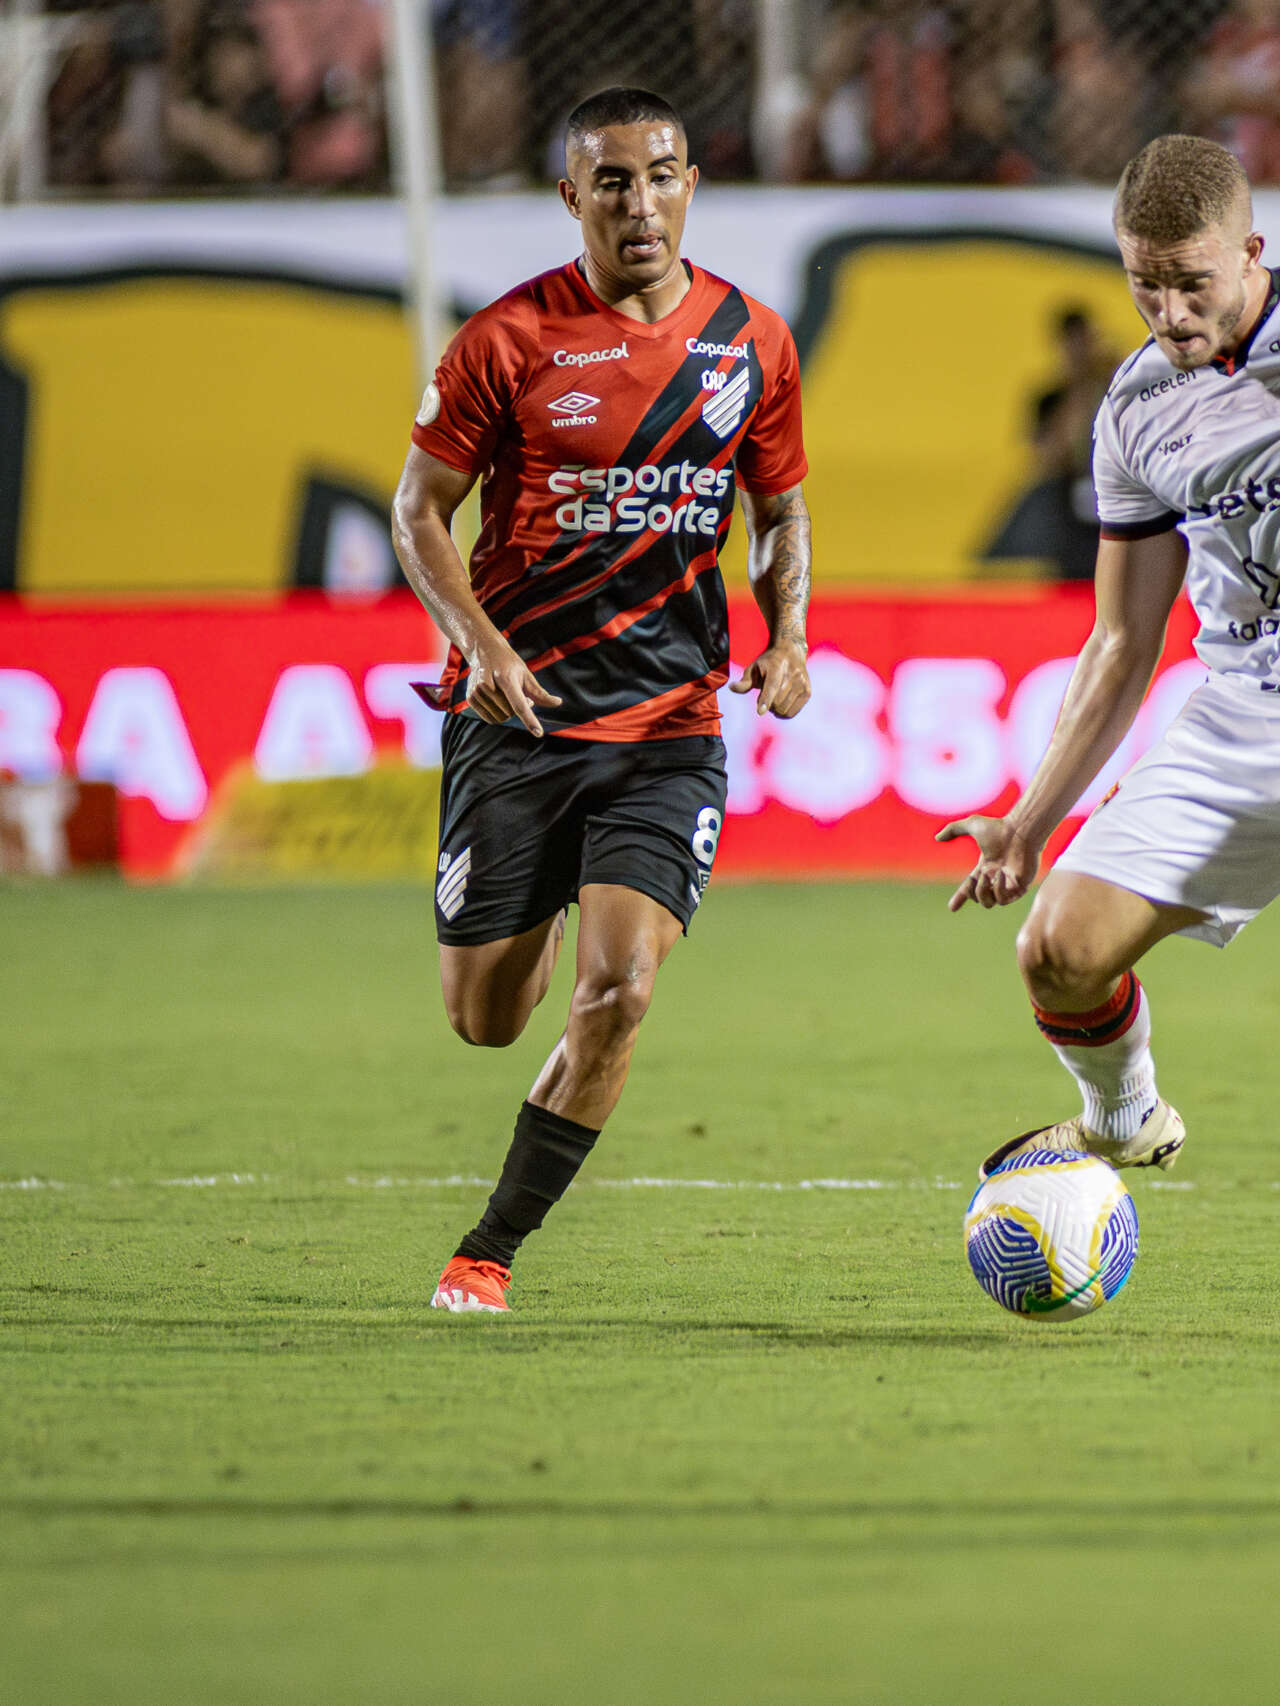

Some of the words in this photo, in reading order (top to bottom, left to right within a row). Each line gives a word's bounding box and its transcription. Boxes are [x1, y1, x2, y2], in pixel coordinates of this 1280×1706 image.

[553, 341, 630, 369] Copacol
[686, 337, 750, 361] Copacol
[1140, 368, 1197, 403] acelen
[551, 414, 598, 429] umbro
[547, 459, 735, 501] Esportes
[614, 497, 721, 537] Sorte
[691, 805, 723, 868] 8
